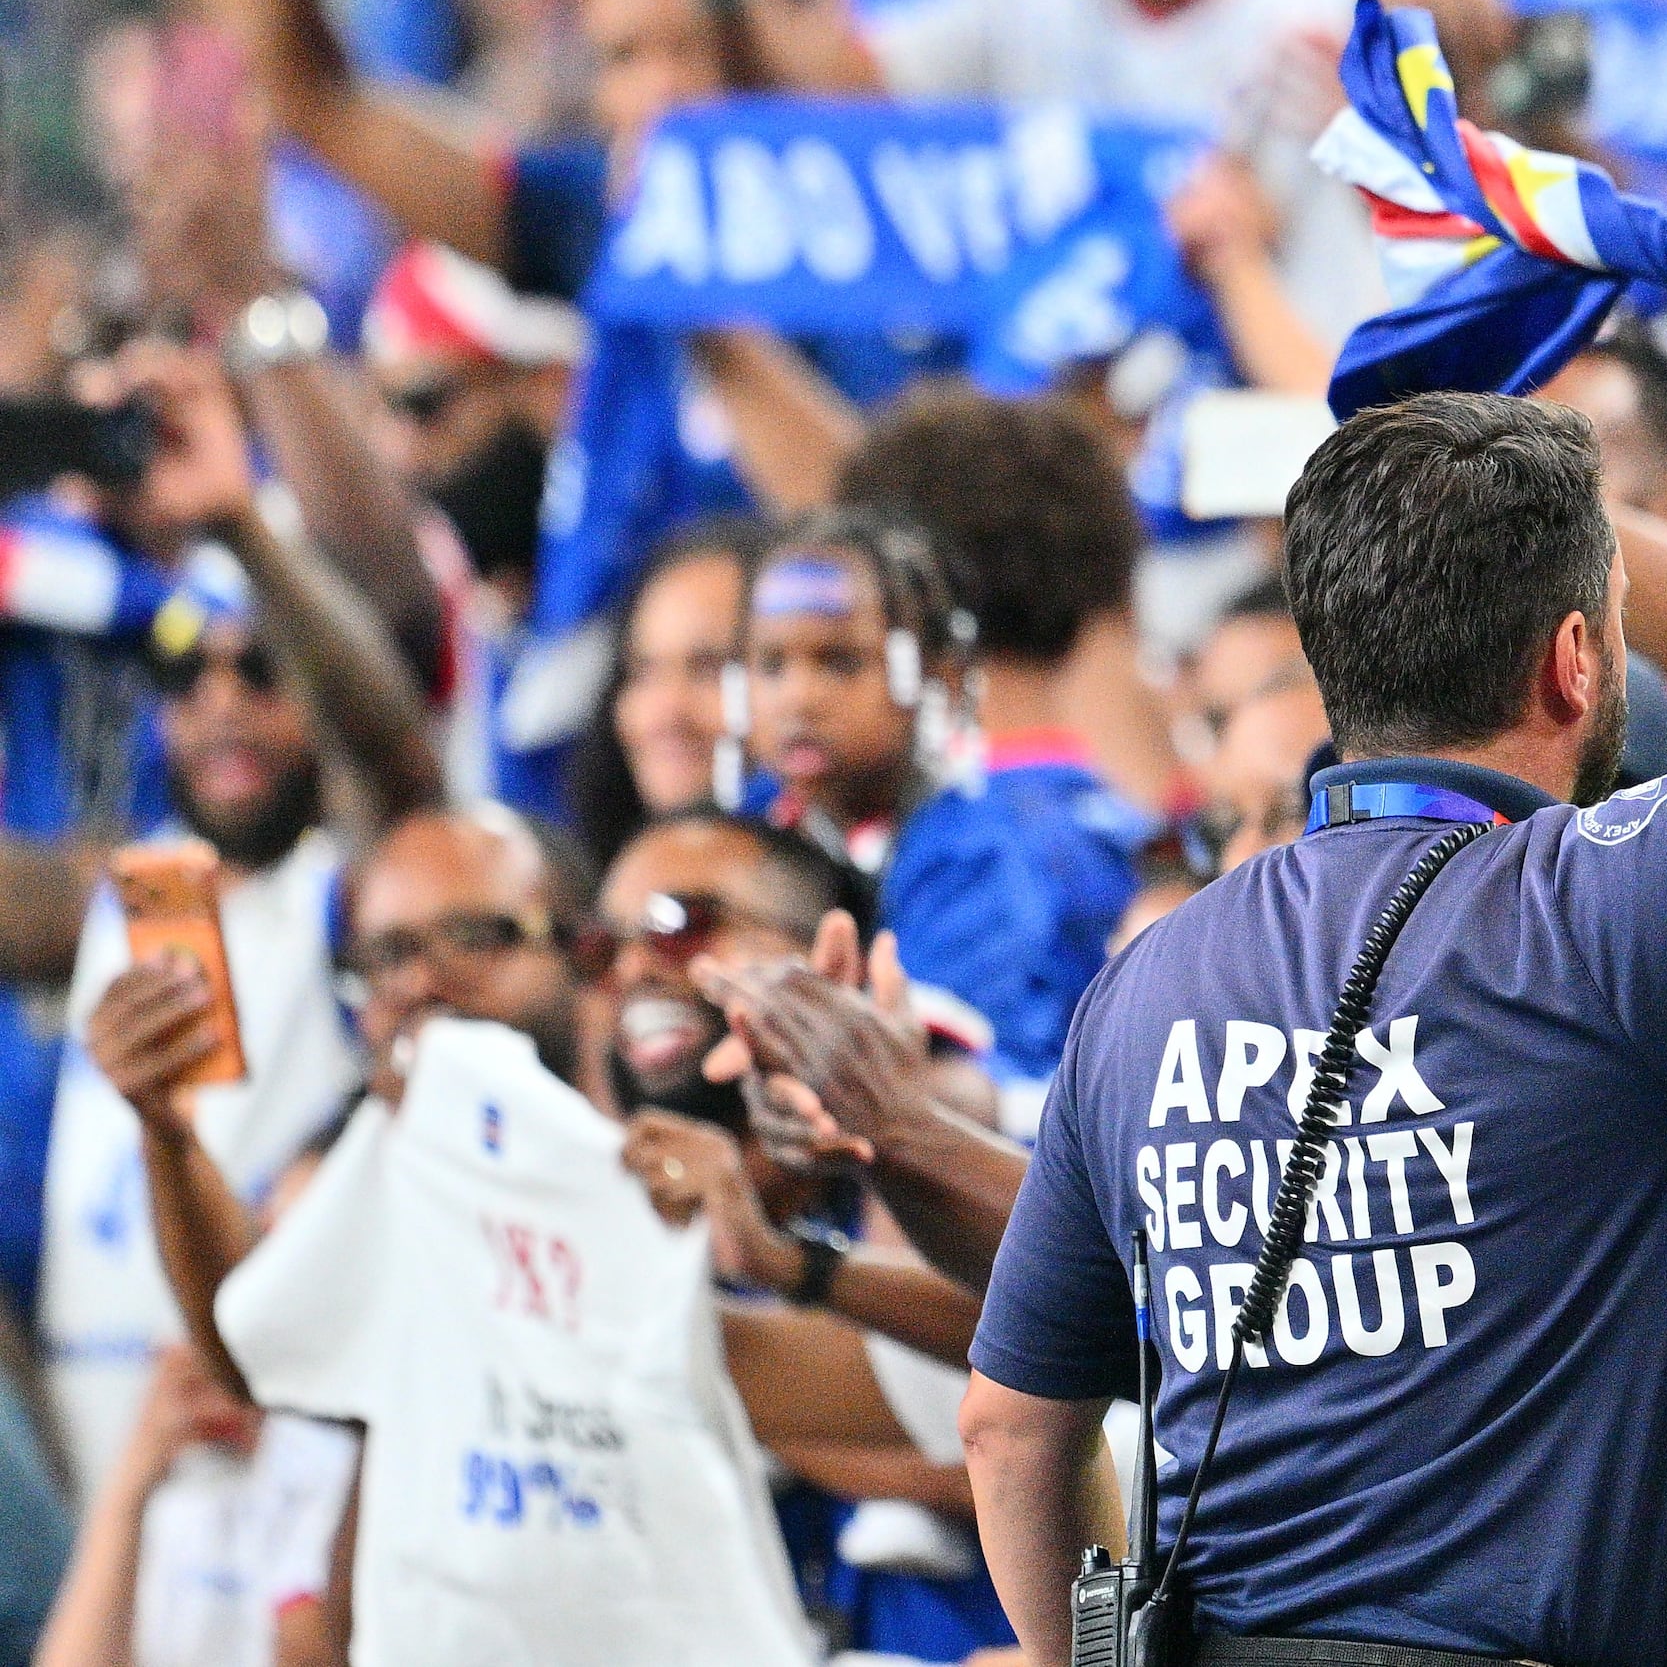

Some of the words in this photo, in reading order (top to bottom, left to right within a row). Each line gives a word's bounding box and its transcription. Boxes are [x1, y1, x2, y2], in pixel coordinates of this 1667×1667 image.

[1602, 818, 1641, 838] APEX
[1148, 1014, 1446, 1129] APEX
[1136, 1120, 1476, 1253] SECURITY
[1164, 1241, 1478, 1374] GROUP
